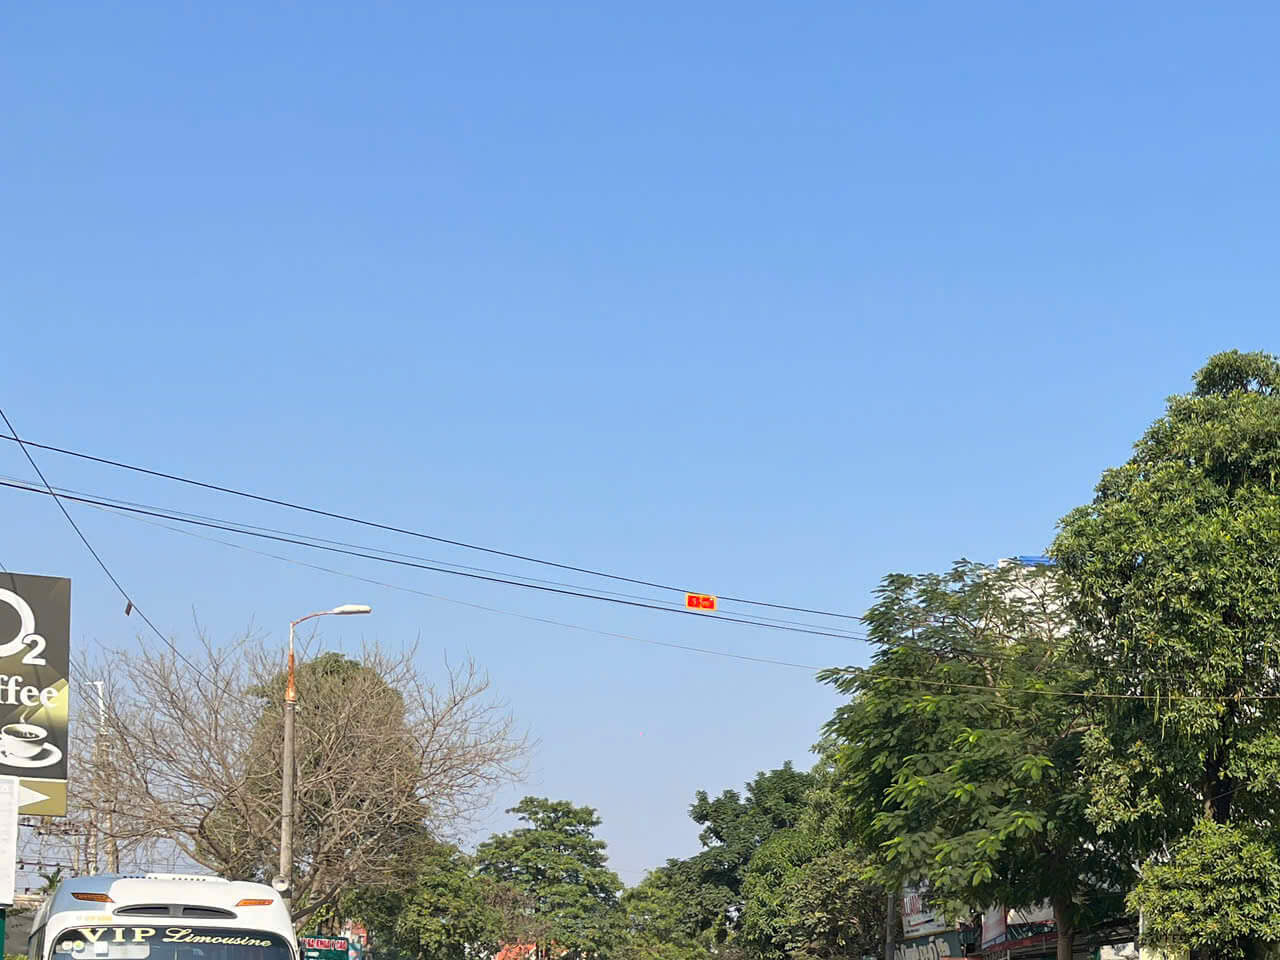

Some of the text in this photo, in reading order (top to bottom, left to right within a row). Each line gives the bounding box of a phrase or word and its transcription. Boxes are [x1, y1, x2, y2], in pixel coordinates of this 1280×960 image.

[0, 674, 58, 707] ffee
[78, 927, 272, 947] VIP Limousine
